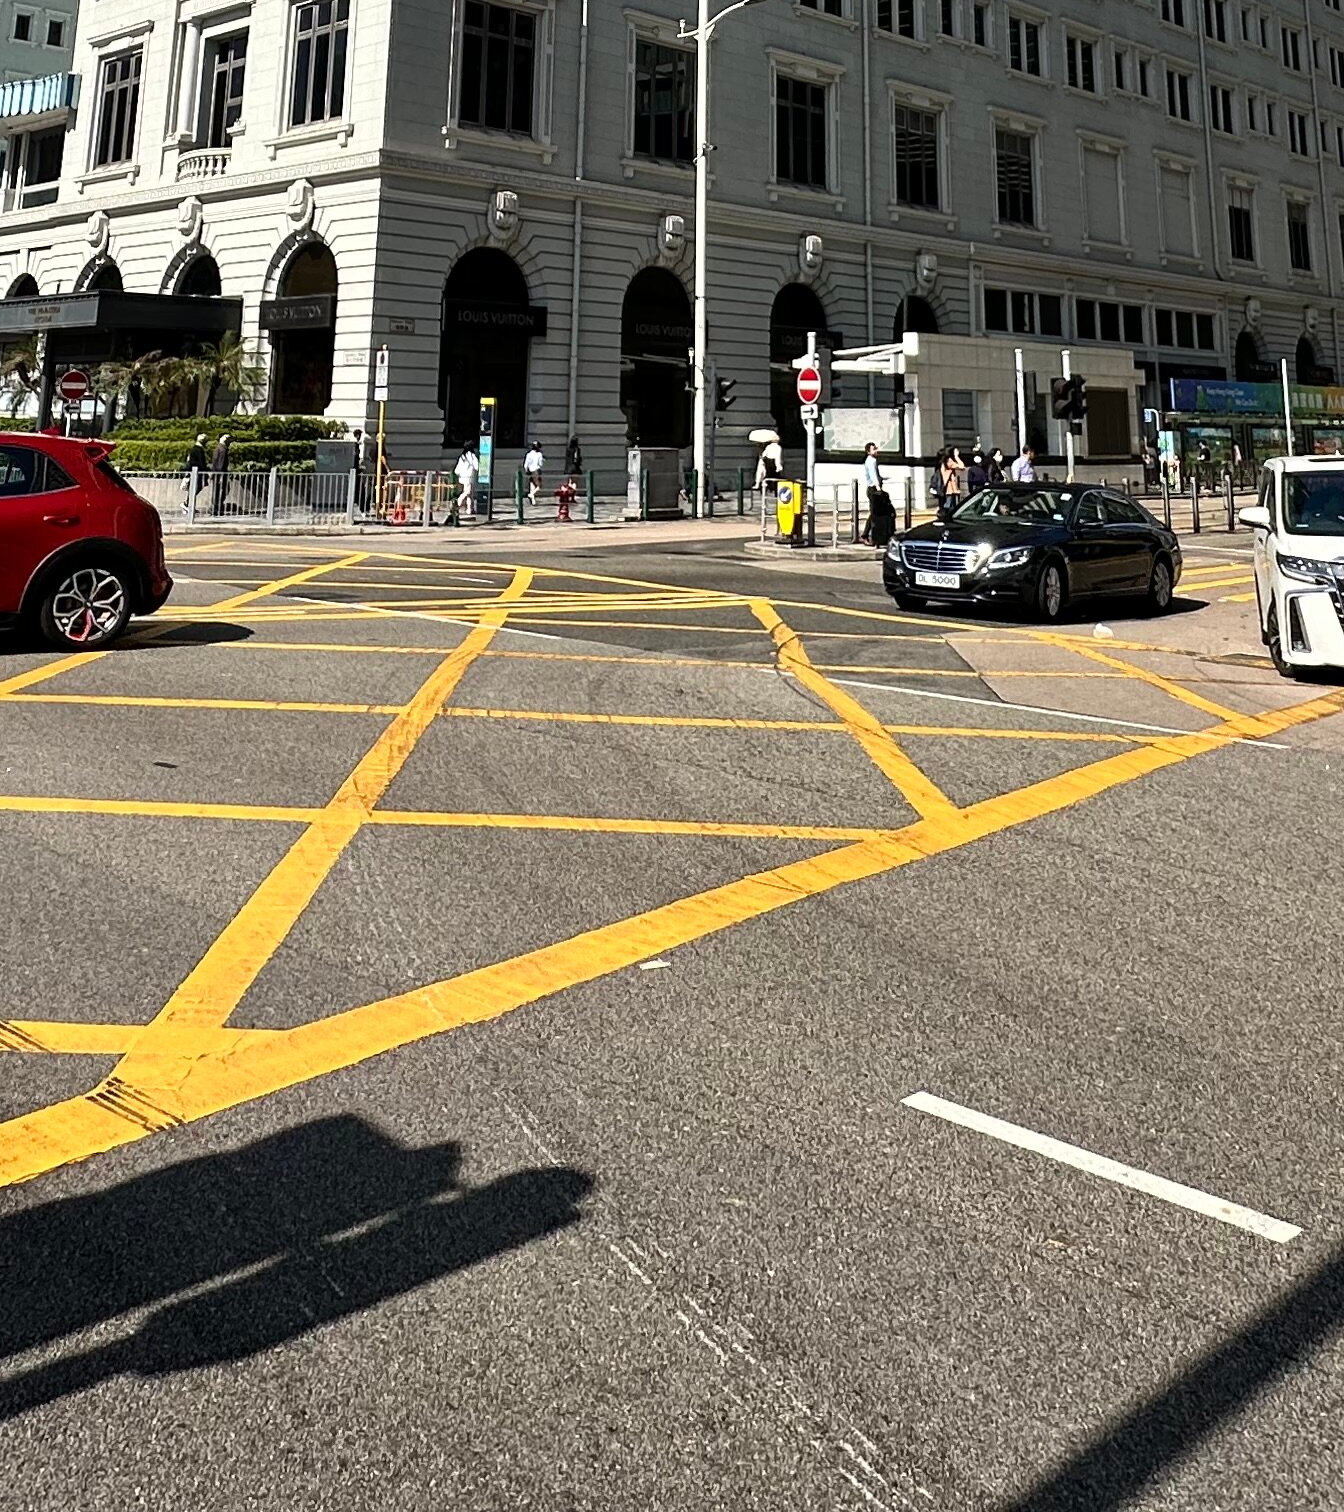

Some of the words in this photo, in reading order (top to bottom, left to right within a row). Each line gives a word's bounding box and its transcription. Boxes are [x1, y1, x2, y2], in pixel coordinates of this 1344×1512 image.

[458, 309, 489, 322] LOUIS
[491, 311, 535, 326] VUITTON
[635, 322, 661, 336] LOUIS
[662, 324, 692, 338] VUITTO
